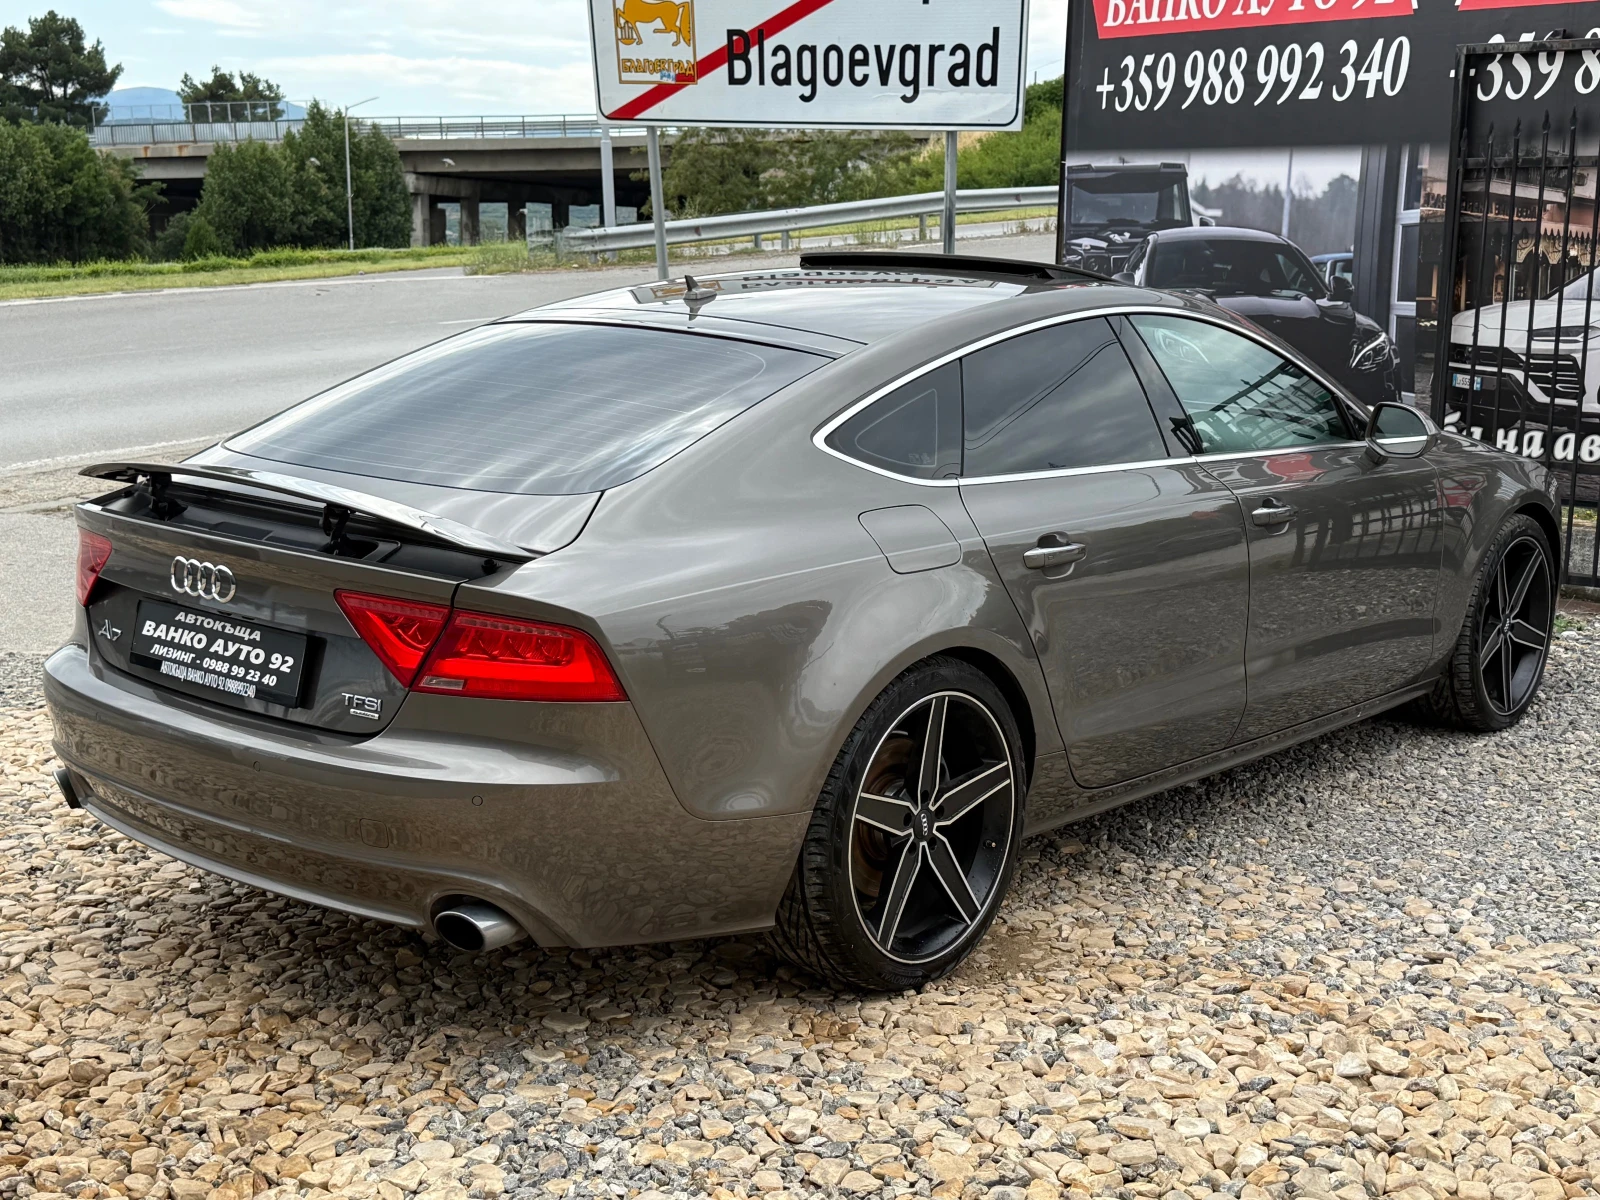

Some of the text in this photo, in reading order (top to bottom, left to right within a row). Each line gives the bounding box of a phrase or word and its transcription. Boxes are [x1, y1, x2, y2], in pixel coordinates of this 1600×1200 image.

[726, 27, 1000, 103] Blagoevgrad
[1096, 35, 1411, 112] +359 988 992 340
[141, 620, 294, 674] ВАНКО АУТО 92
[174, 611, 261, 642] АВТОКЪЩА
[150, 643, 196, 664] ЛИЗИНГ
[202, 657, 230, 674] 0988
[230, 665, 246, 678] 99
[246, 669, 261, 682] 23
[261, 673, 277, 687] 40
[187, 667, 205, 685] ВАНКО
[204, 672, 218, 688] АУТО
[341, 692, 382, 712] TFSI
